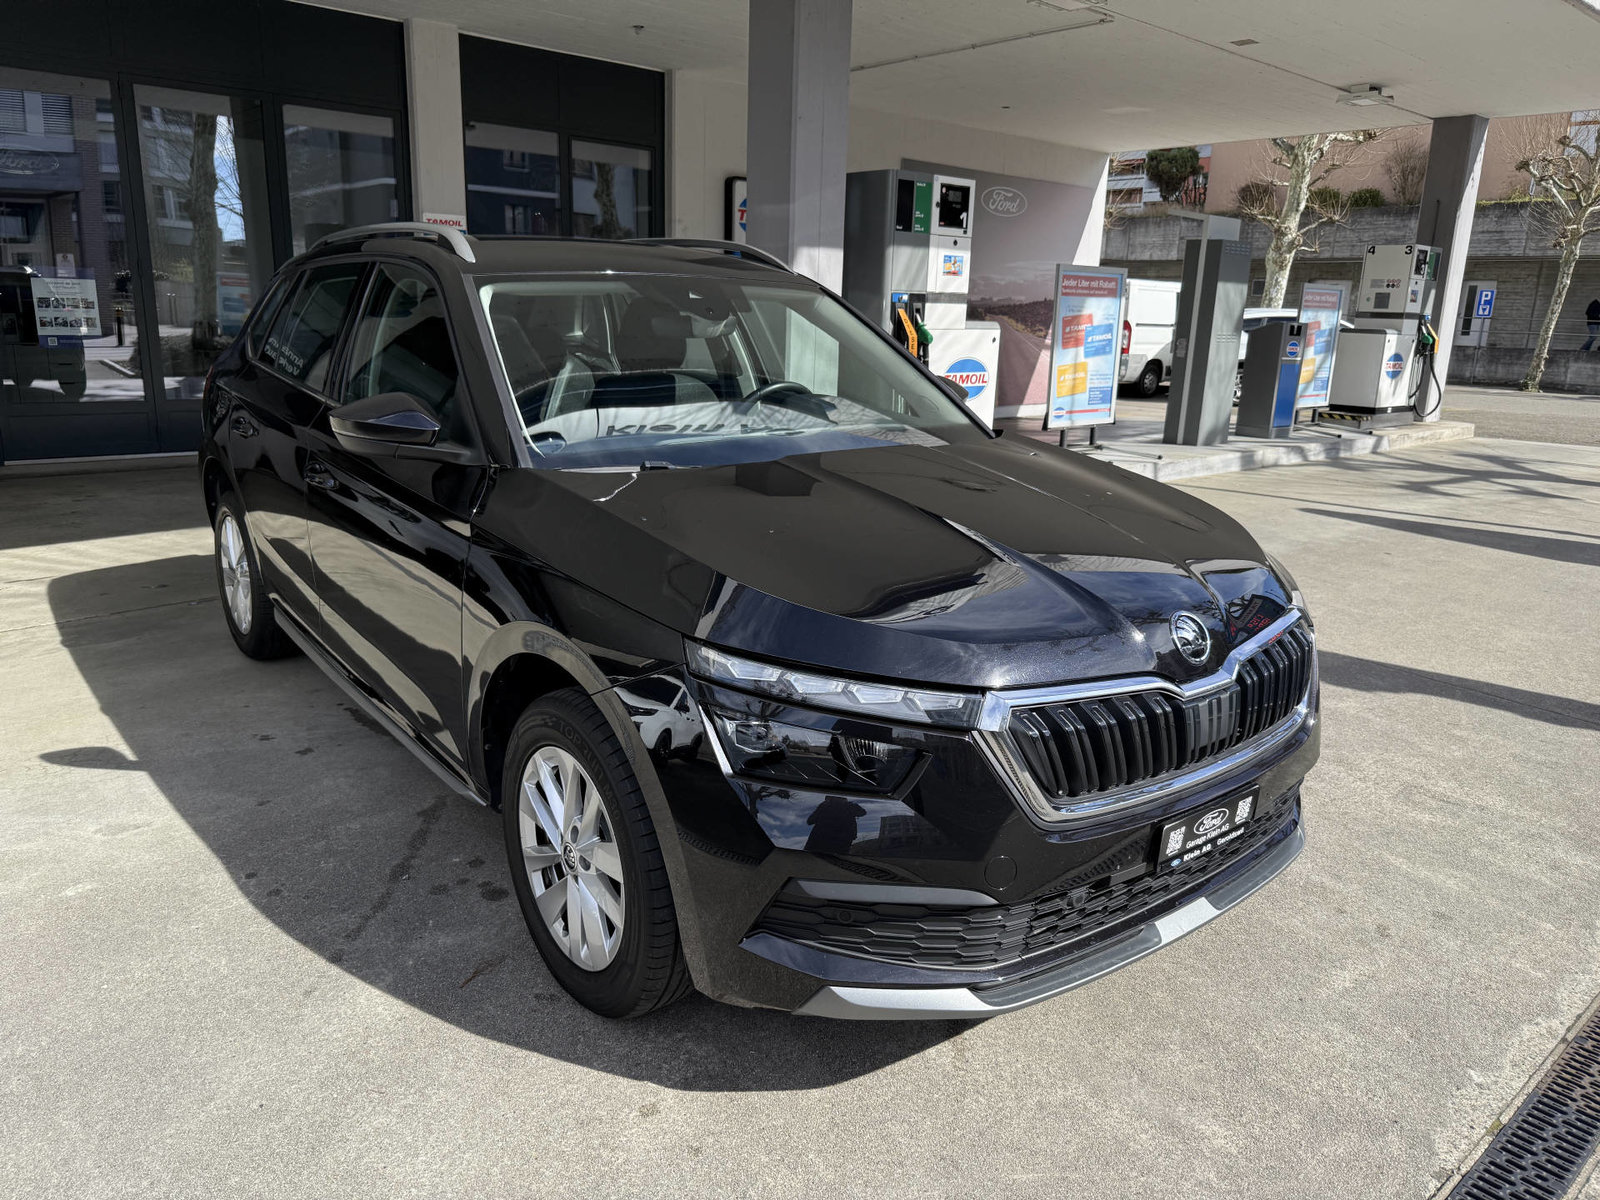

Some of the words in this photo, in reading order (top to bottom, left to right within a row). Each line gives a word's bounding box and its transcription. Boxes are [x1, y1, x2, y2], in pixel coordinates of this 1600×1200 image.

[988, 189, 1021, 213] Ford
[426, 218, 463, 227] TAMOIL
[960, 211, 968, 228] 1
[1367, 245, 1376, 255] 4
[1404, 245, 1413, 255] 3
[1481, 291, 1492, 305] P
[1199, 812, 1223, 832] Ford
[1186, 835, 1207, 849] Garage
[1206, 827, 1220, 840] Klein
[1220, 823, 1230, 834] AG
[1183, 849, 1201, 861] Klein
